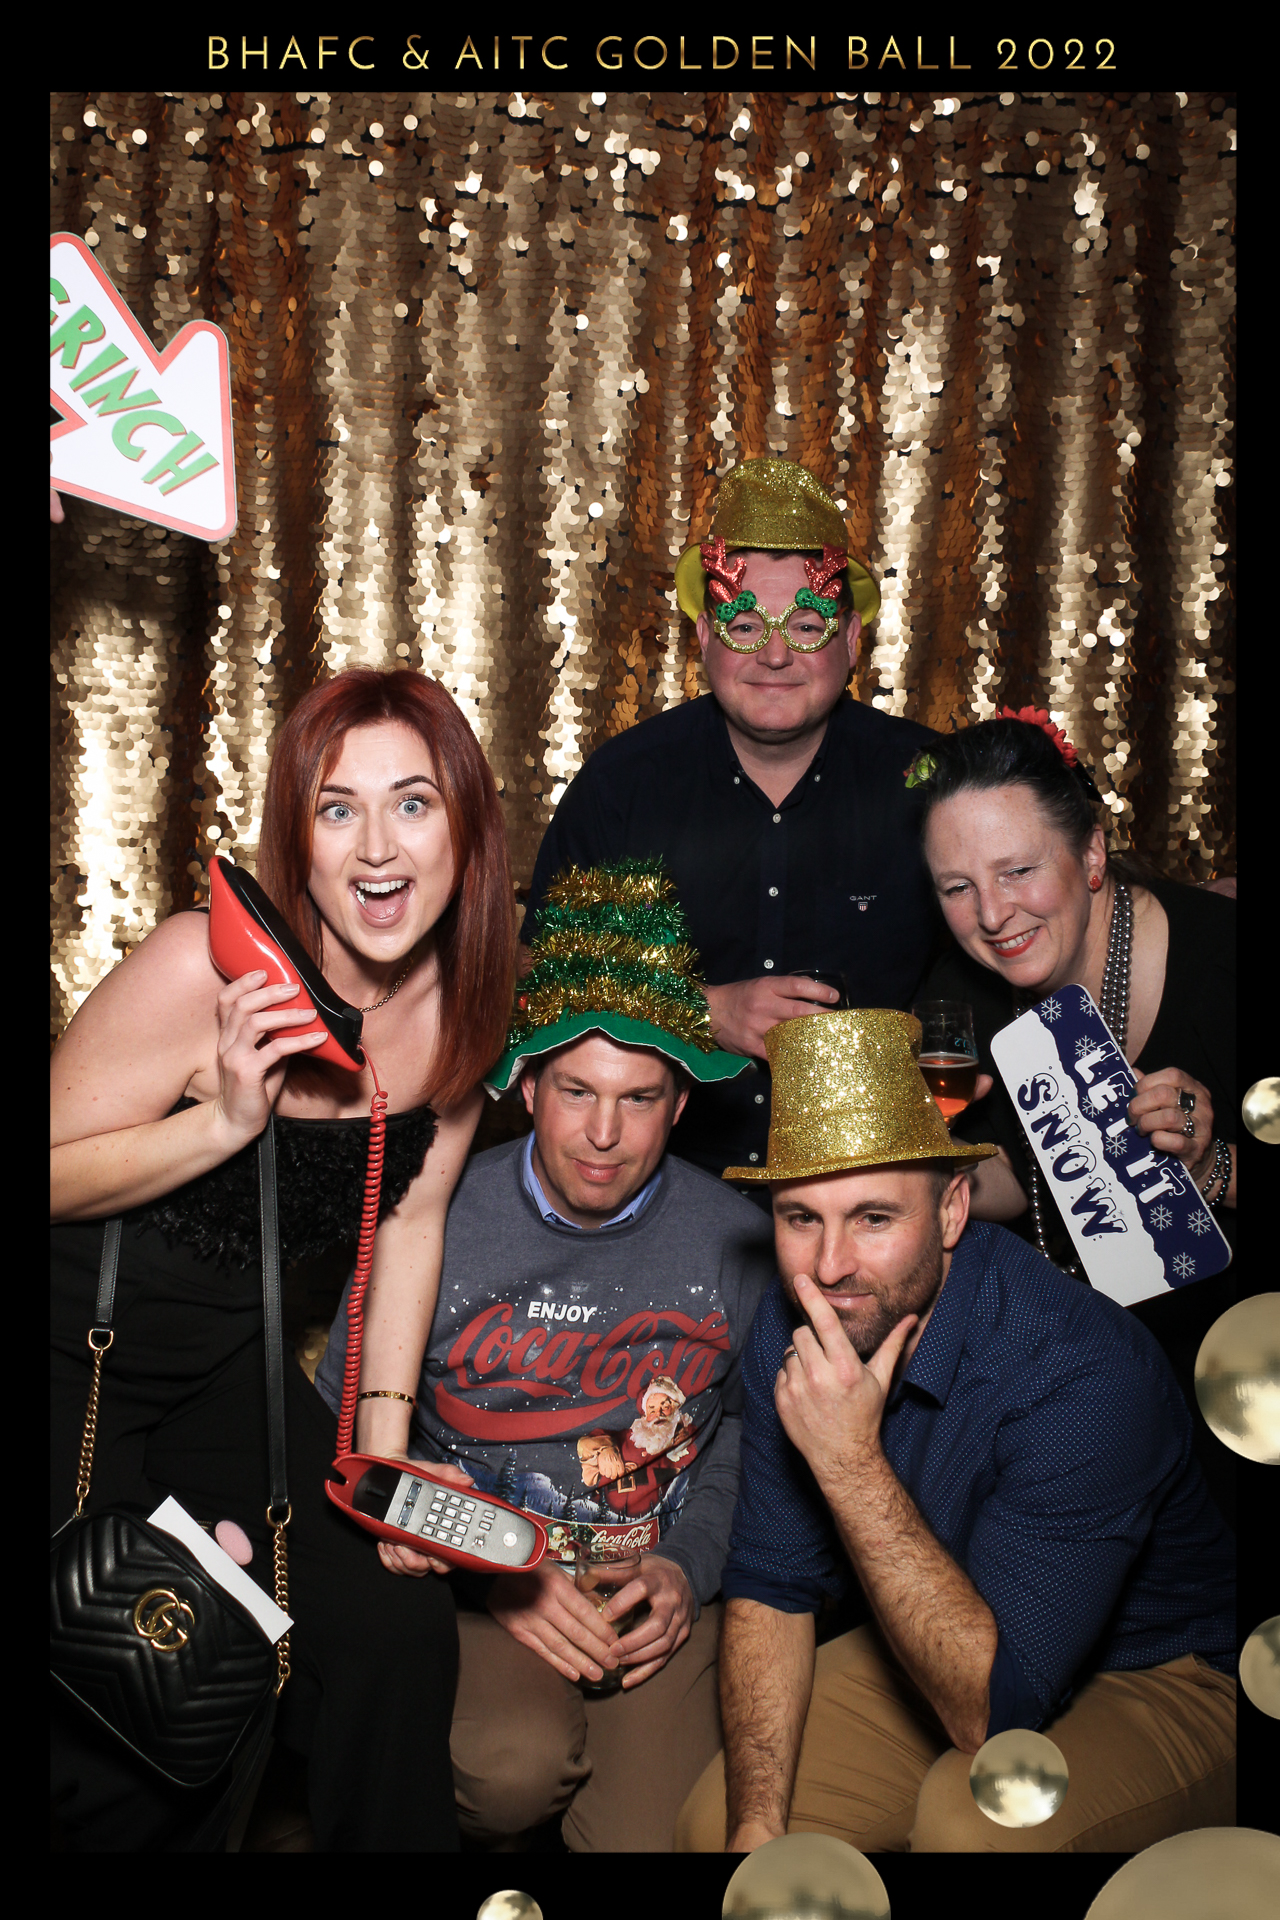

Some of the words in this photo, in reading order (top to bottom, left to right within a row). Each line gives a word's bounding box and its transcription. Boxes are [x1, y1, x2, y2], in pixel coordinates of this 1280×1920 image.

[1017, 1072, 1128, 1237] SNOW
[527, 1301, 597, 1323] ENJOY
[447, 1302, 731, 1399] Coca-Cola
[591, 1522, 654, 1550] Coca-Cola
